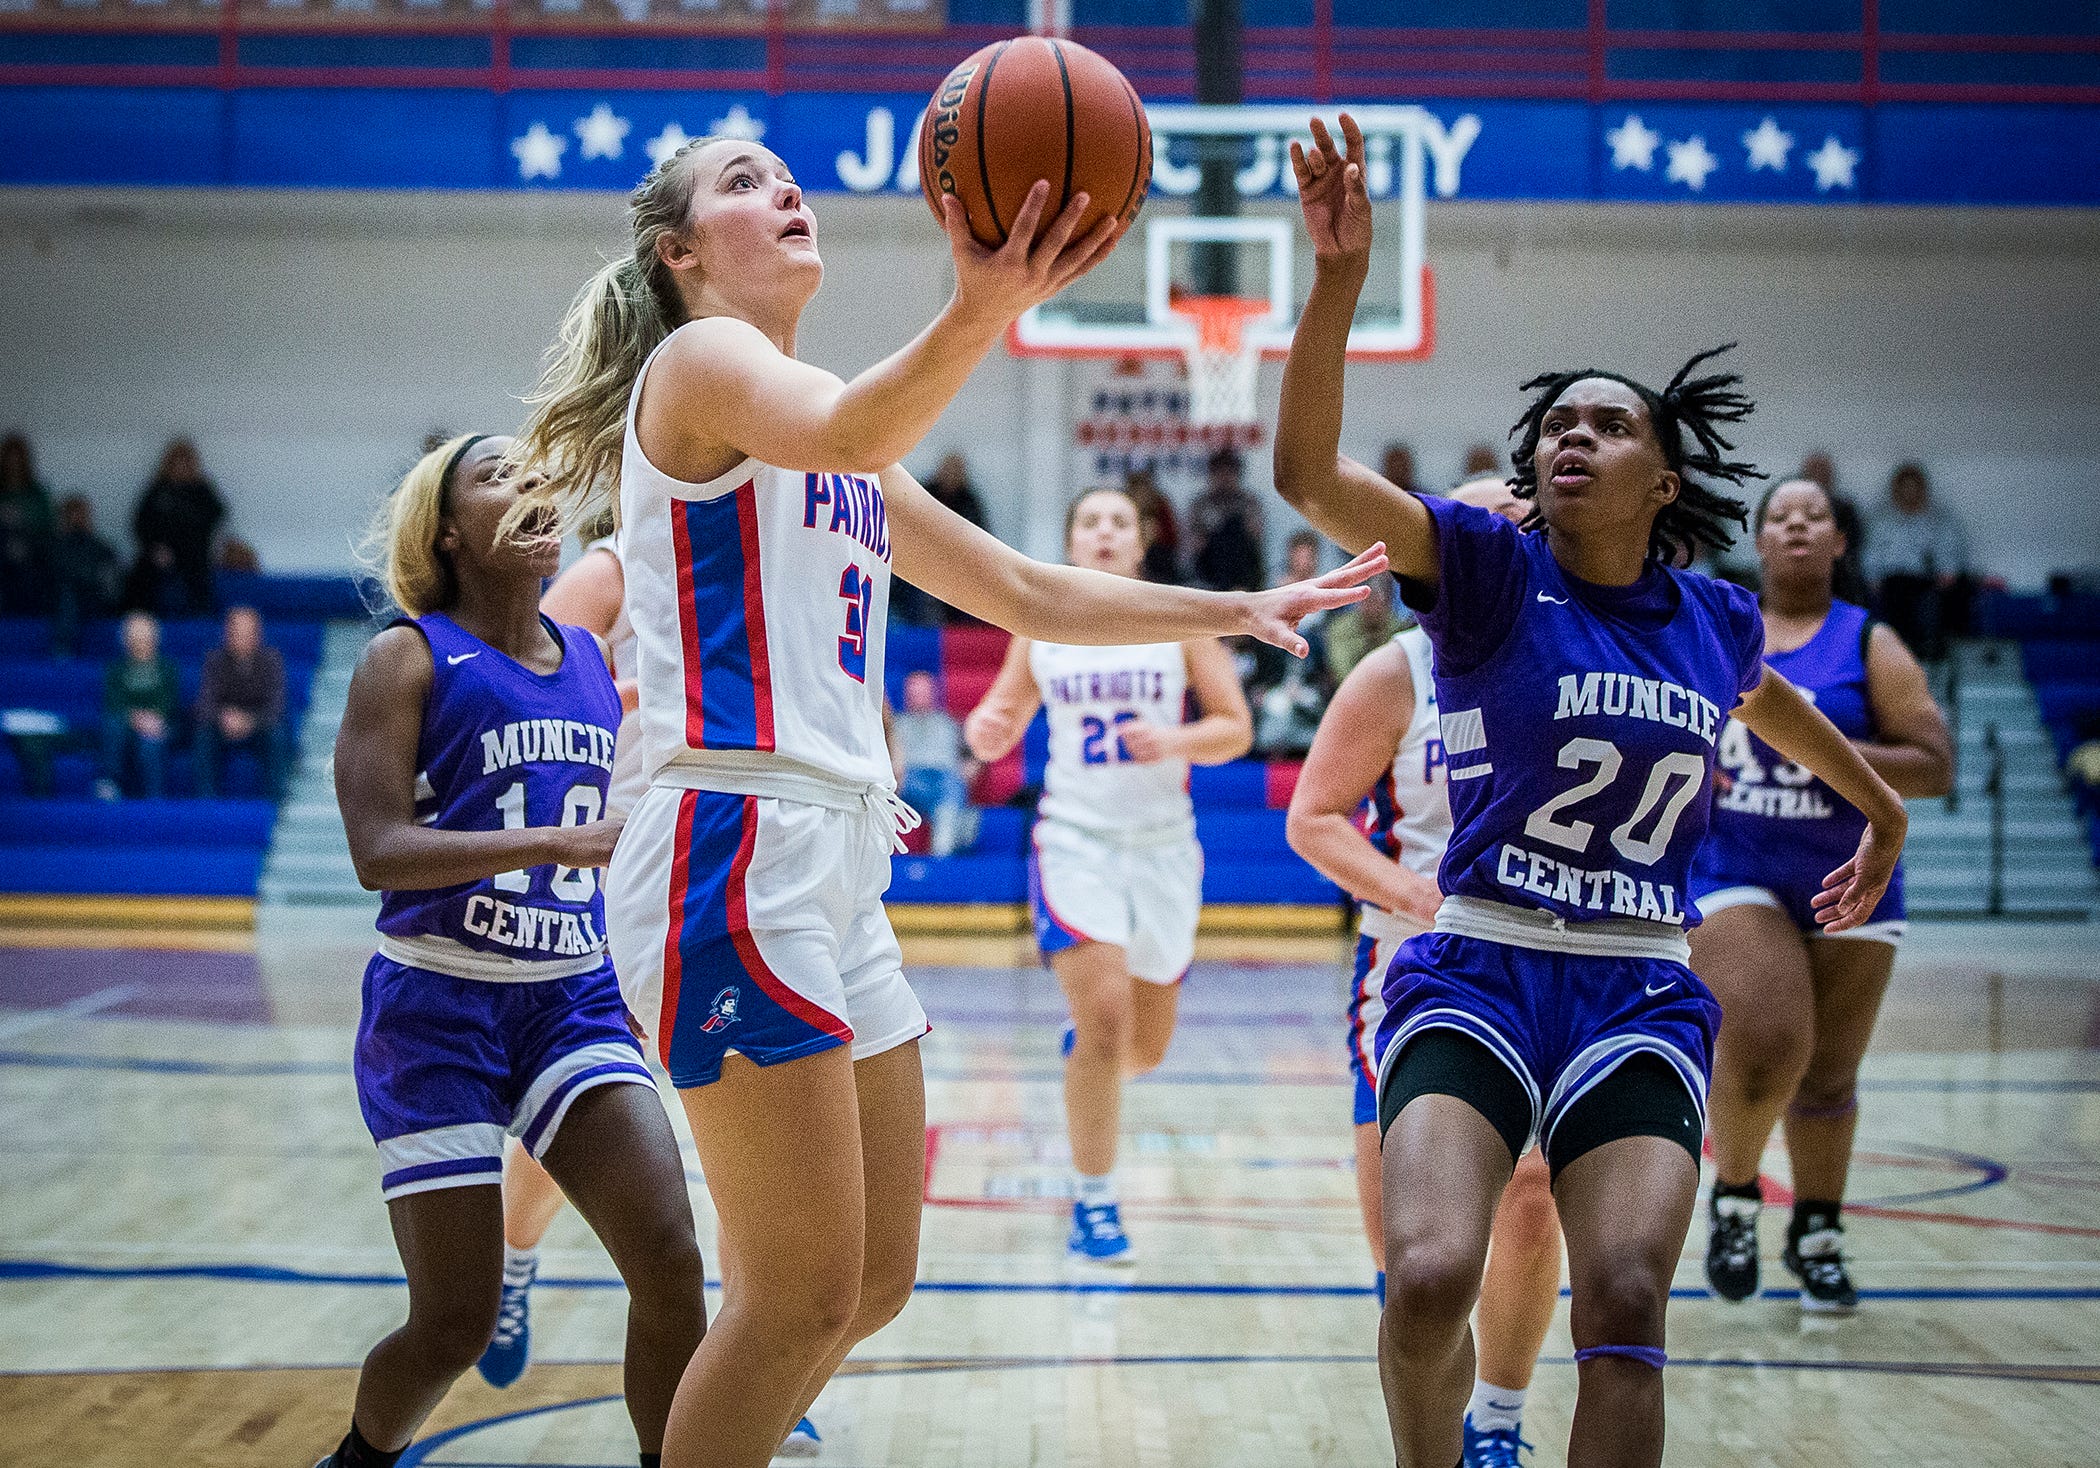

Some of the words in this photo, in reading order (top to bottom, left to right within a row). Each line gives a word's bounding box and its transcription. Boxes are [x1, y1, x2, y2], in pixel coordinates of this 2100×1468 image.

[937, 64, 980, 196] Wilso
[480, 719, 615, 776] MUNCIE
[1553, 671, 1720, 748] MUNCIE
[494, 782, 602, 904] 10
[1523, 736, 1706, 867] 20
[463, 894, 607, 956] CENTRAL
[1496, 842, 1686, 926] CENTRAL
